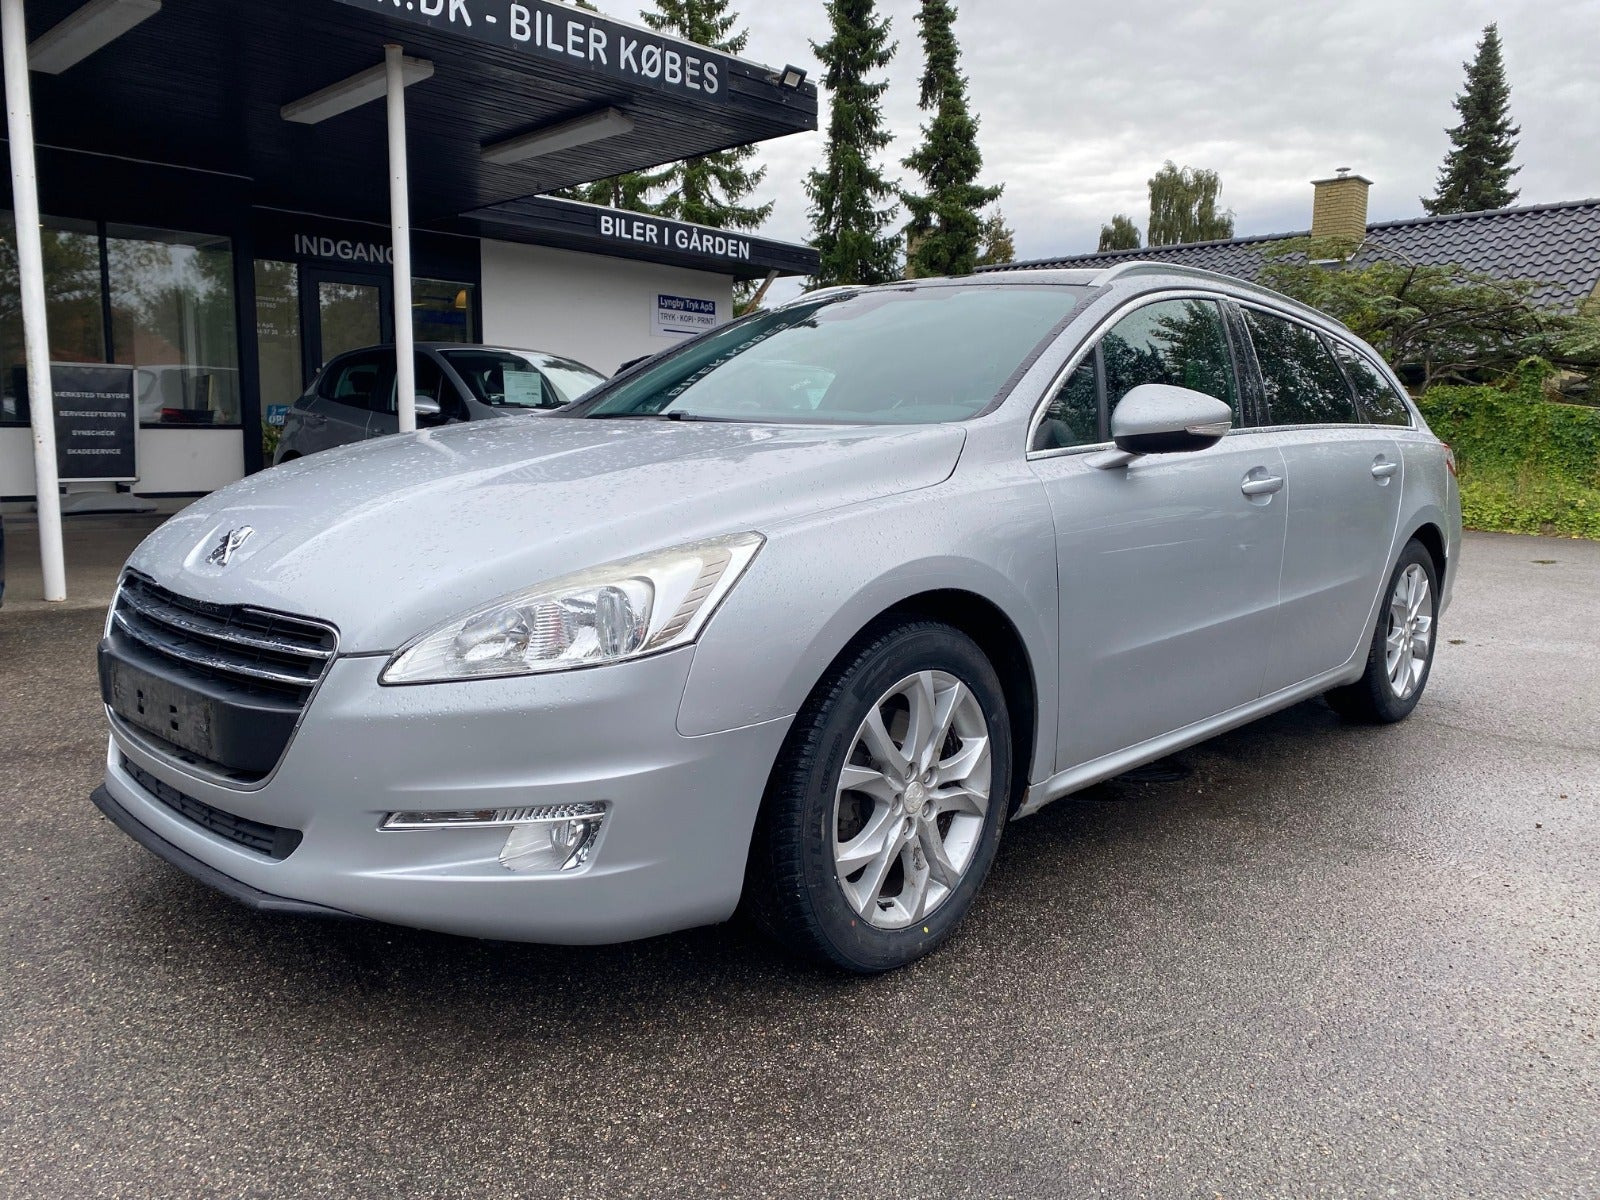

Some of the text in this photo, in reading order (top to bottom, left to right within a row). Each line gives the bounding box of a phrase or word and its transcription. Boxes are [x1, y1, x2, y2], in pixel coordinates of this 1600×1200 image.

[510, 3, 608, 65] BILER
[619, 36, 719, 94] KØBES
[600, 215, 750, 260] BILER I GÅRDEN
[660, 296, 714, 312] Lyngby Tryk ApS
[660, 312, 714, 325] TRYK KOPI PRINT
